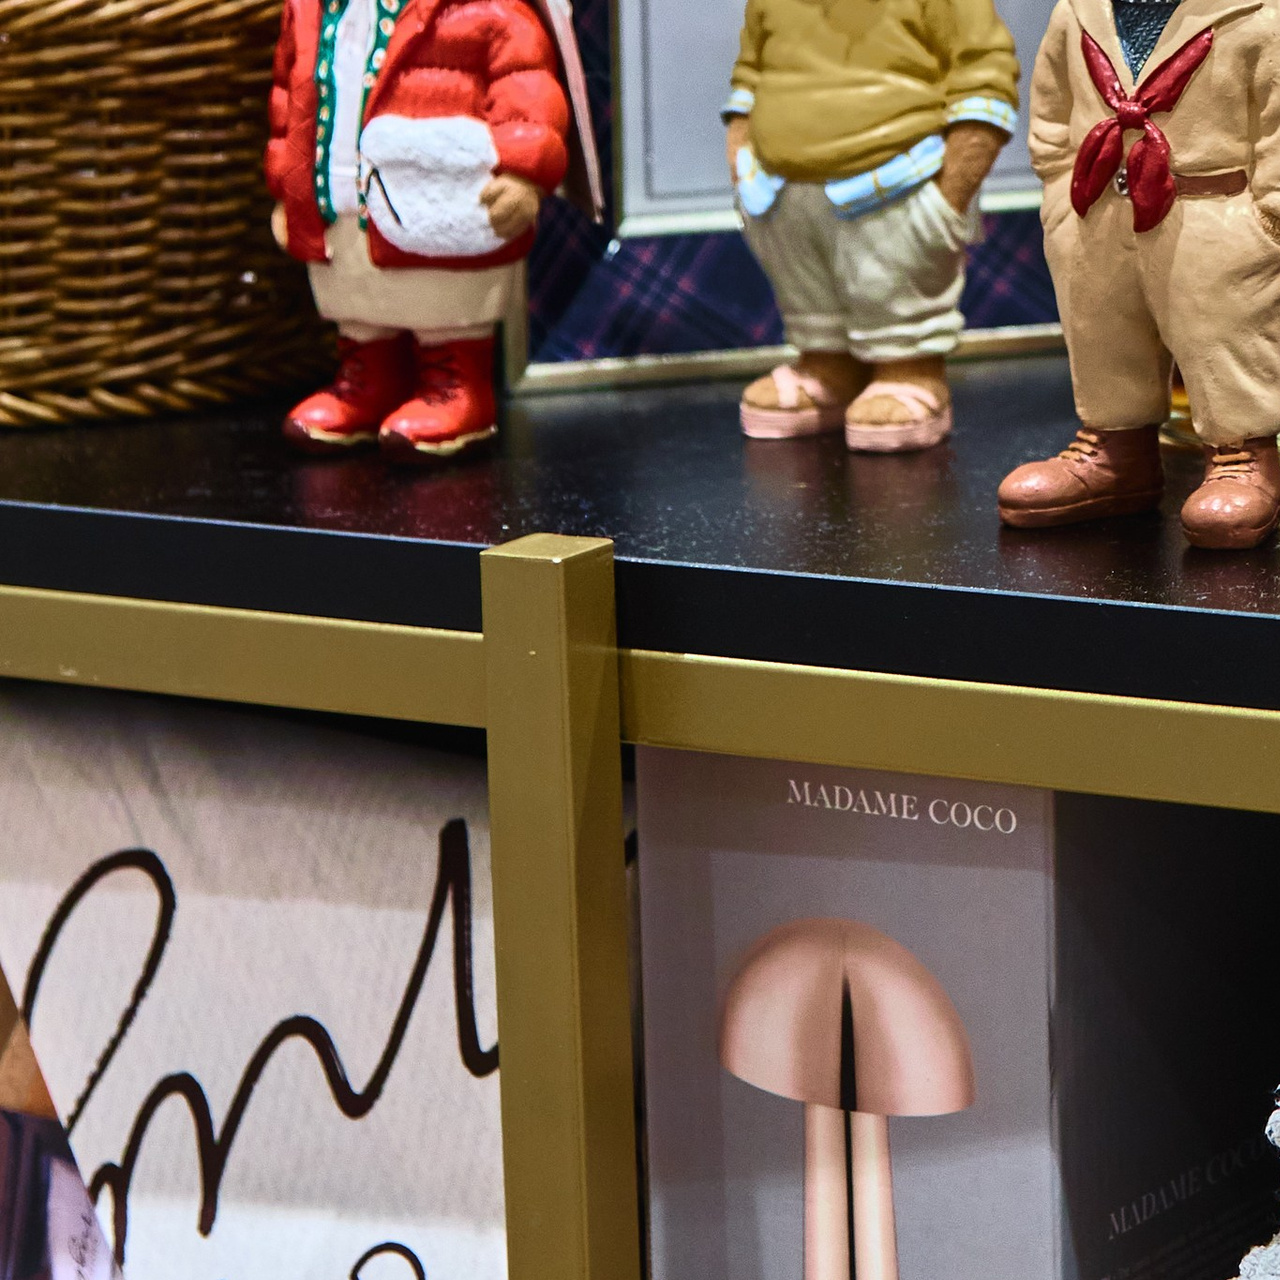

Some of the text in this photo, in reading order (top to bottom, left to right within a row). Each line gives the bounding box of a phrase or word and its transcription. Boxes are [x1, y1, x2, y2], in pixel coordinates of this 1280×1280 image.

[786, 779, 1018, 835] MADAME COCO
[1108, 1167, 1202, 1241] MADAME
